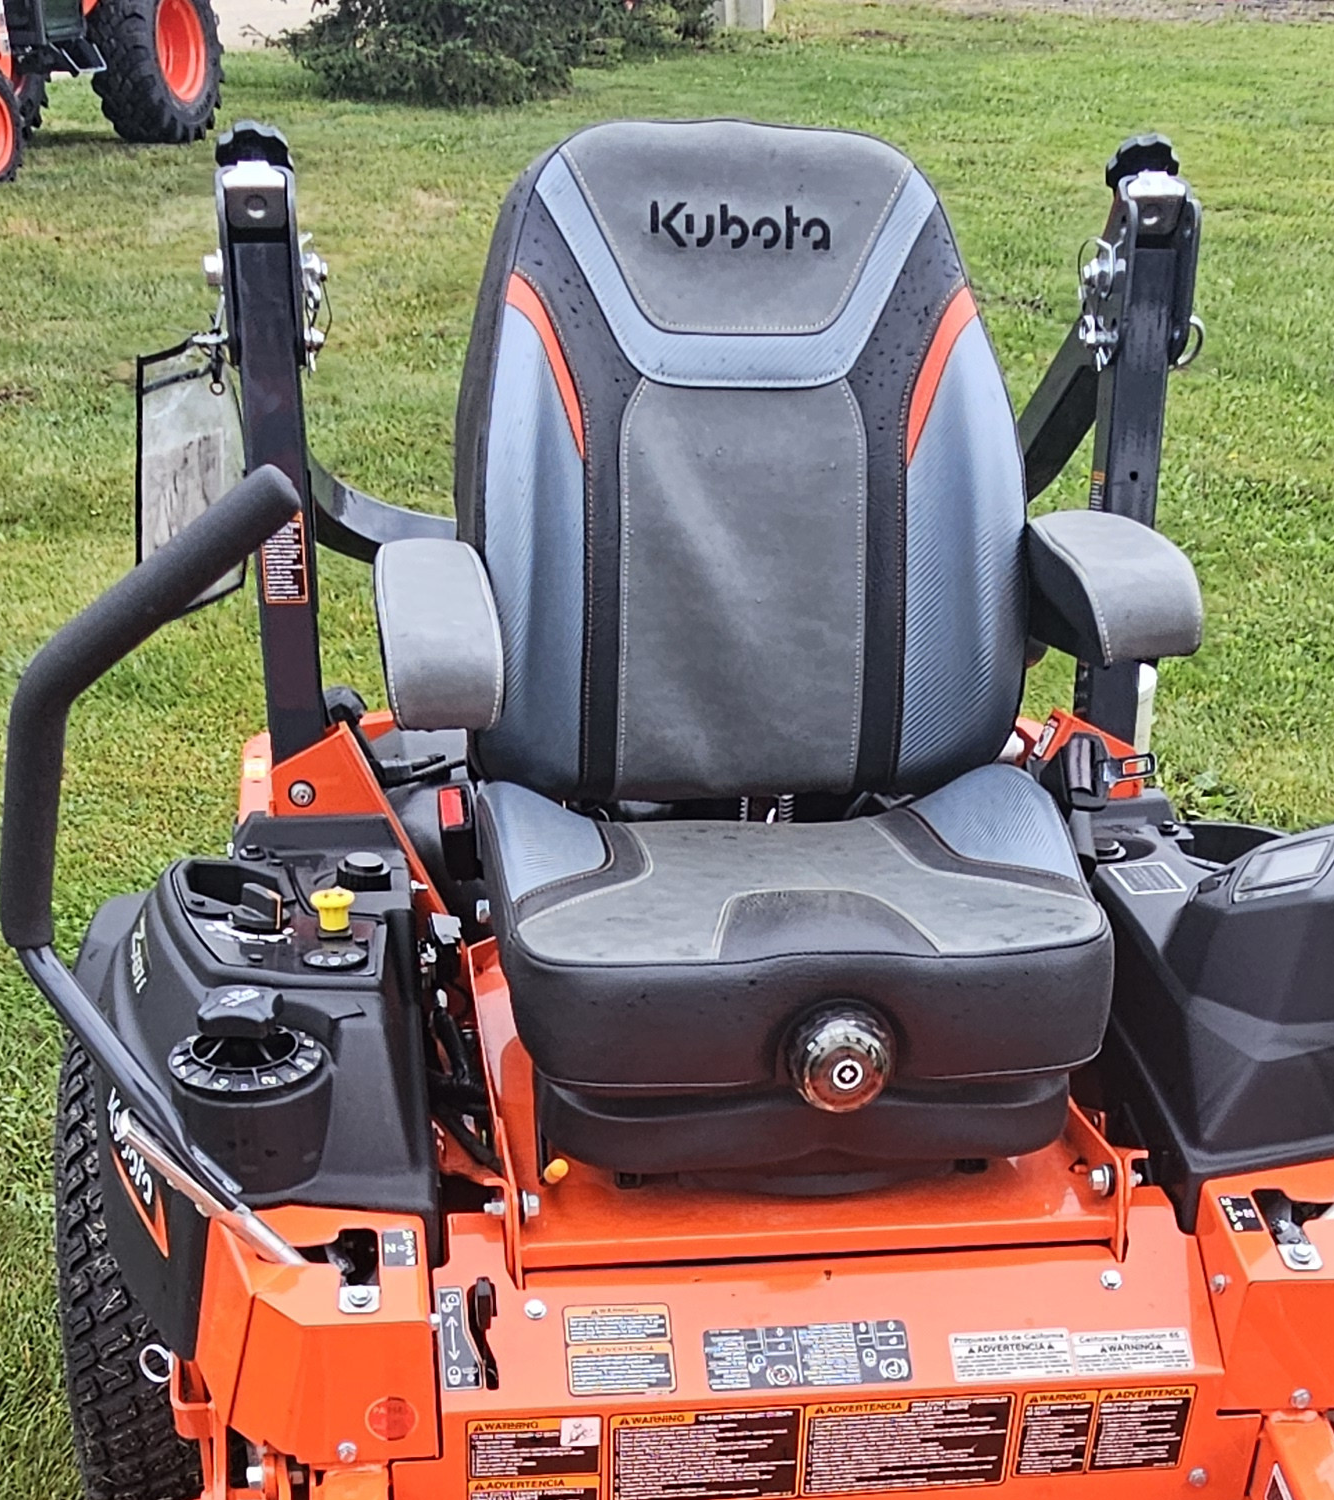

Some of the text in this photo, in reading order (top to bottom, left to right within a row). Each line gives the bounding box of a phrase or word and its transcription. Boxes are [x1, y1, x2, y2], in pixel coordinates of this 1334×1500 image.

[650, 201, 831, 250] Kubota
[1121, 1333, 1166, 1342] Proposition
[977, 1342, 1045, 1353] ADVERTENCIA
[1109, 1342, 1156, 1352] WARNING
[1039, 1393, 1087, 1402] WARNING
[1116, 1388, 1190, 1399] ADVERTENCIA
[827, 1402, 902, 1414] ADVERTENCIA
[631, 1414, 685, 1424] WARNING
[484, 1421, 539, 1430] WARNING
[487, 1479, 565, 1489] ADVERTENCIA
